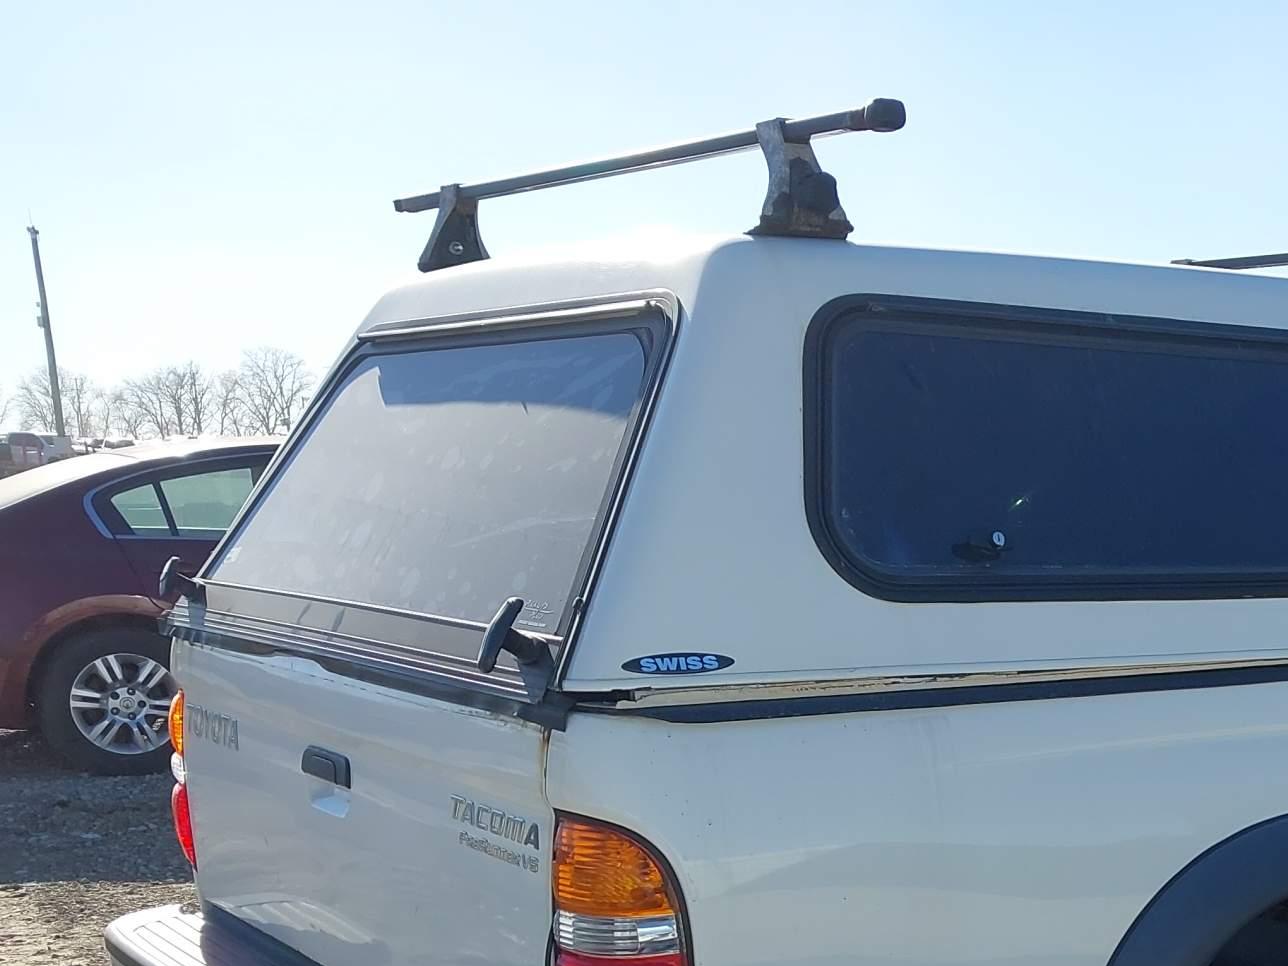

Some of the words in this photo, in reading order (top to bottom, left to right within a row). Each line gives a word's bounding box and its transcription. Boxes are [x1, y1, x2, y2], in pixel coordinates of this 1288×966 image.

[639, 655, 720, 673] SWISS
[185, 703, 239, 751] TOYOTA
[450, 793, 540, 851] TACOMA
